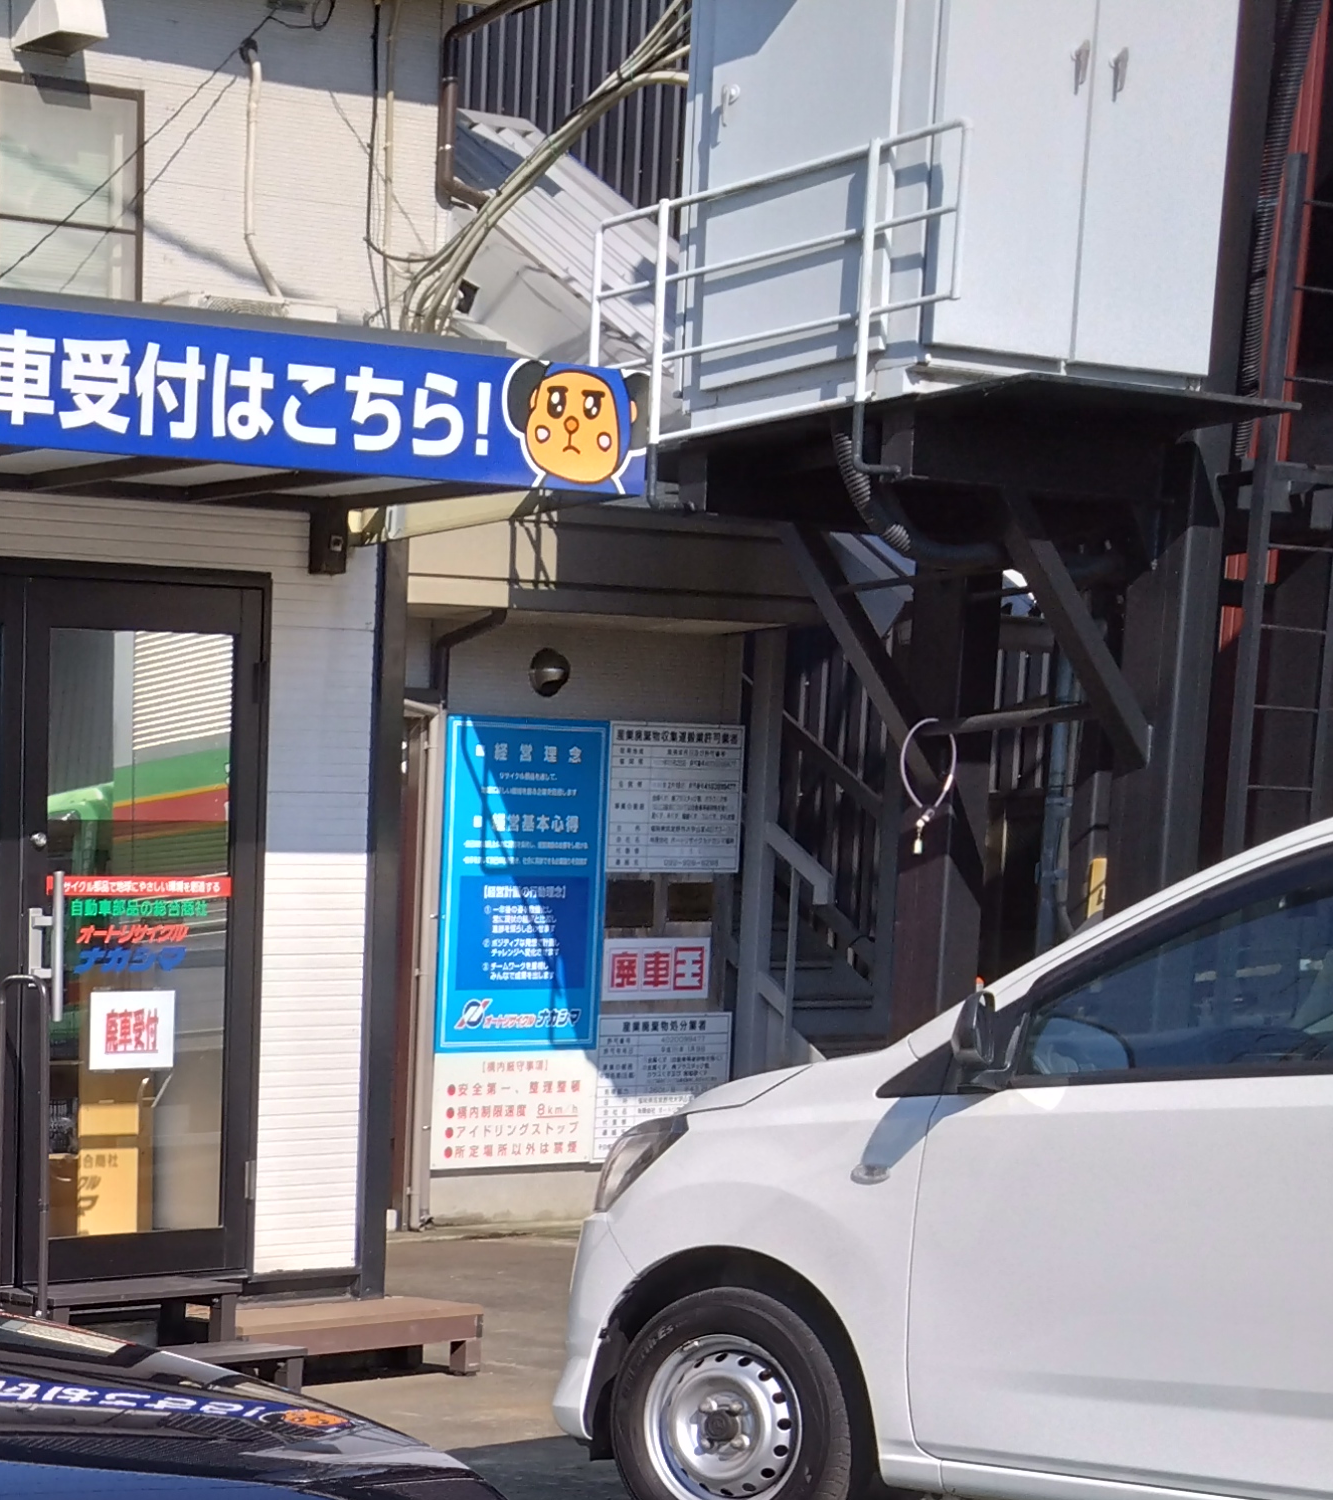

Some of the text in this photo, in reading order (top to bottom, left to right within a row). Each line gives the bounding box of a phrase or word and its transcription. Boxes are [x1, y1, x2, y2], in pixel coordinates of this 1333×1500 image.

[494, 743, 582, 763] 経営理念
[492, 813, 579, 833] 経営基本心得
[70, 899, 209, 917] 自動車部品の総合商社
[76, 924, 190, 944] オートリサイクル
[73, 946, 187, 974] ナカシマ
[610, 946, 705, 991] 廃車王
[104, 1007, 159, 1052] 廃車受付
[456, 1121, 579, 1138] アイドリングストップ
